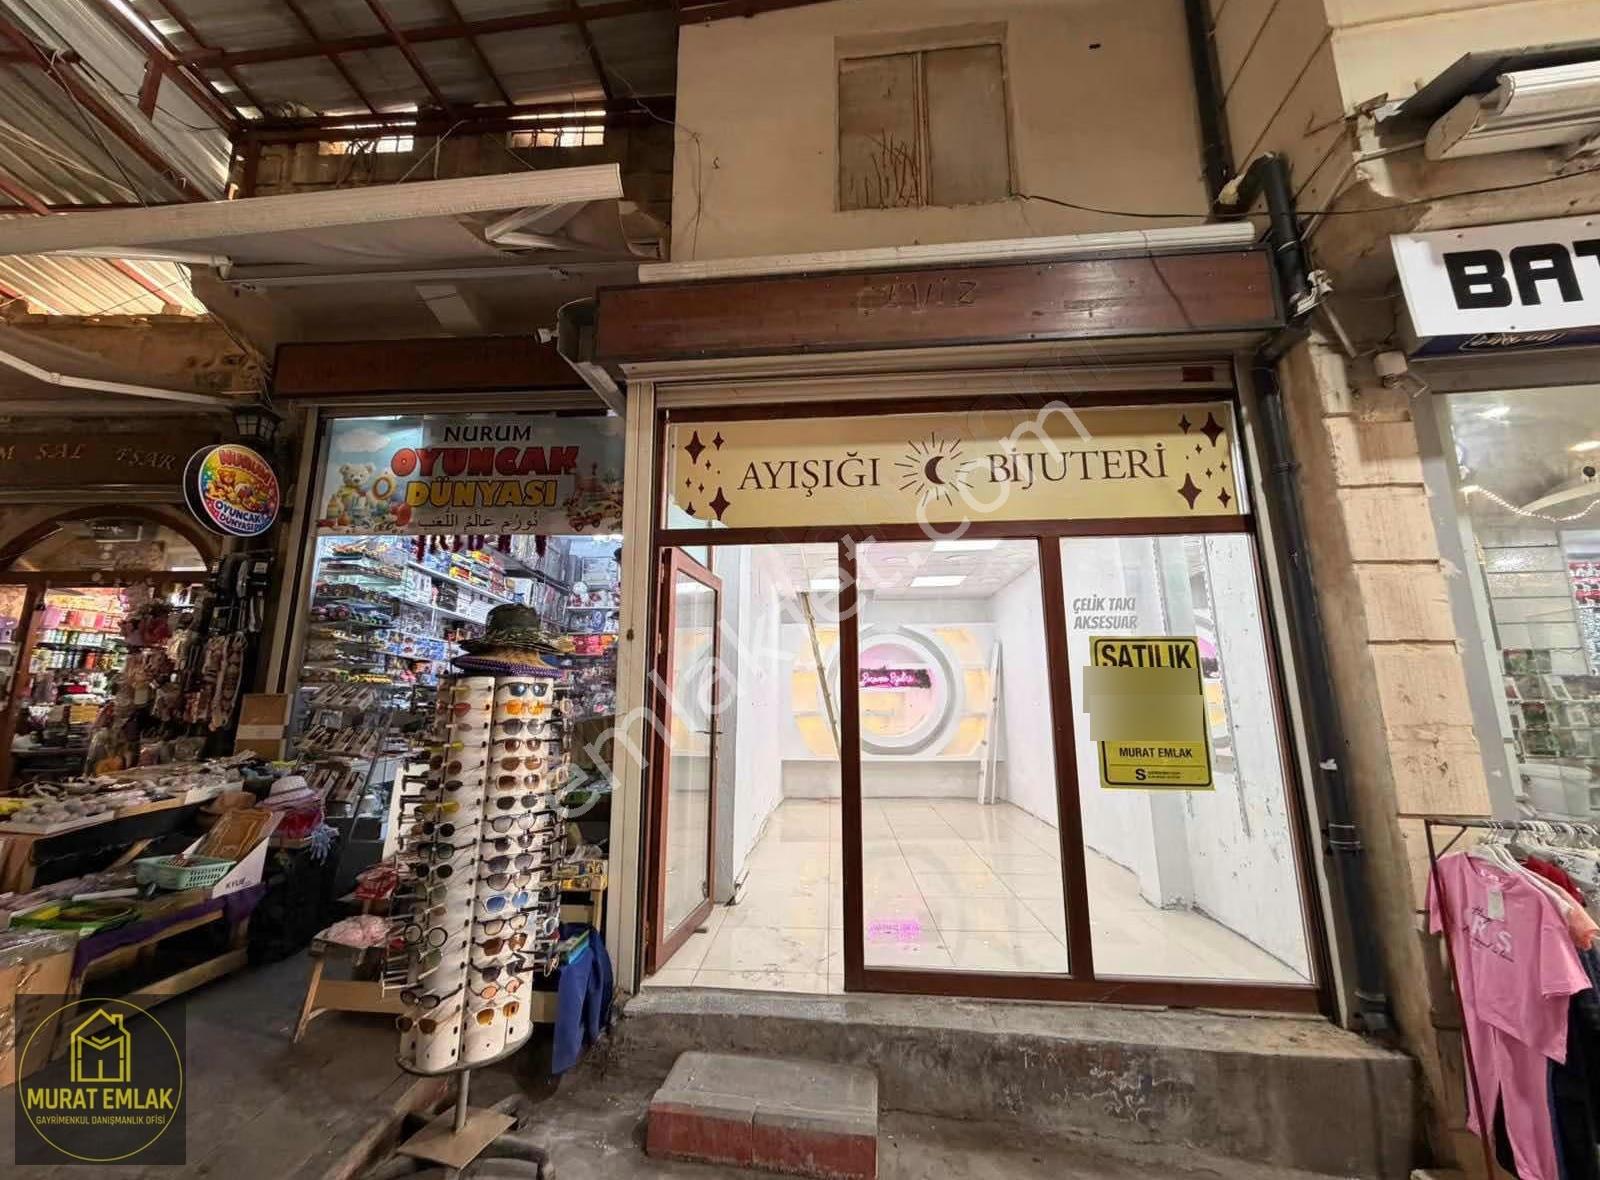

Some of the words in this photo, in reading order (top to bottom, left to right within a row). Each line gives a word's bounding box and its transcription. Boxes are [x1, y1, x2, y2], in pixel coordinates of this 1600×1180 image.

[444, 425, 531, 442] NURUM
[391, 446, 580, 477] OYUNCAK
[737, 451, 881, 498] AYIŞIĞI
[986, 442, 1169, 490] BİJUTERİ
[405, 476, 558, 508] DÜNYASI
[1072, 594, 1106, 614] ÇELİK
[1108, 597, 1137, 612] TAKI
[1073, 615, 1138, 630] AKSESUAR
[1101, 644, 1192, 668] SATILIK
[1119, 747, 1155, 759] MURAT
[1158, 747, 1193, 759] EMLAK
